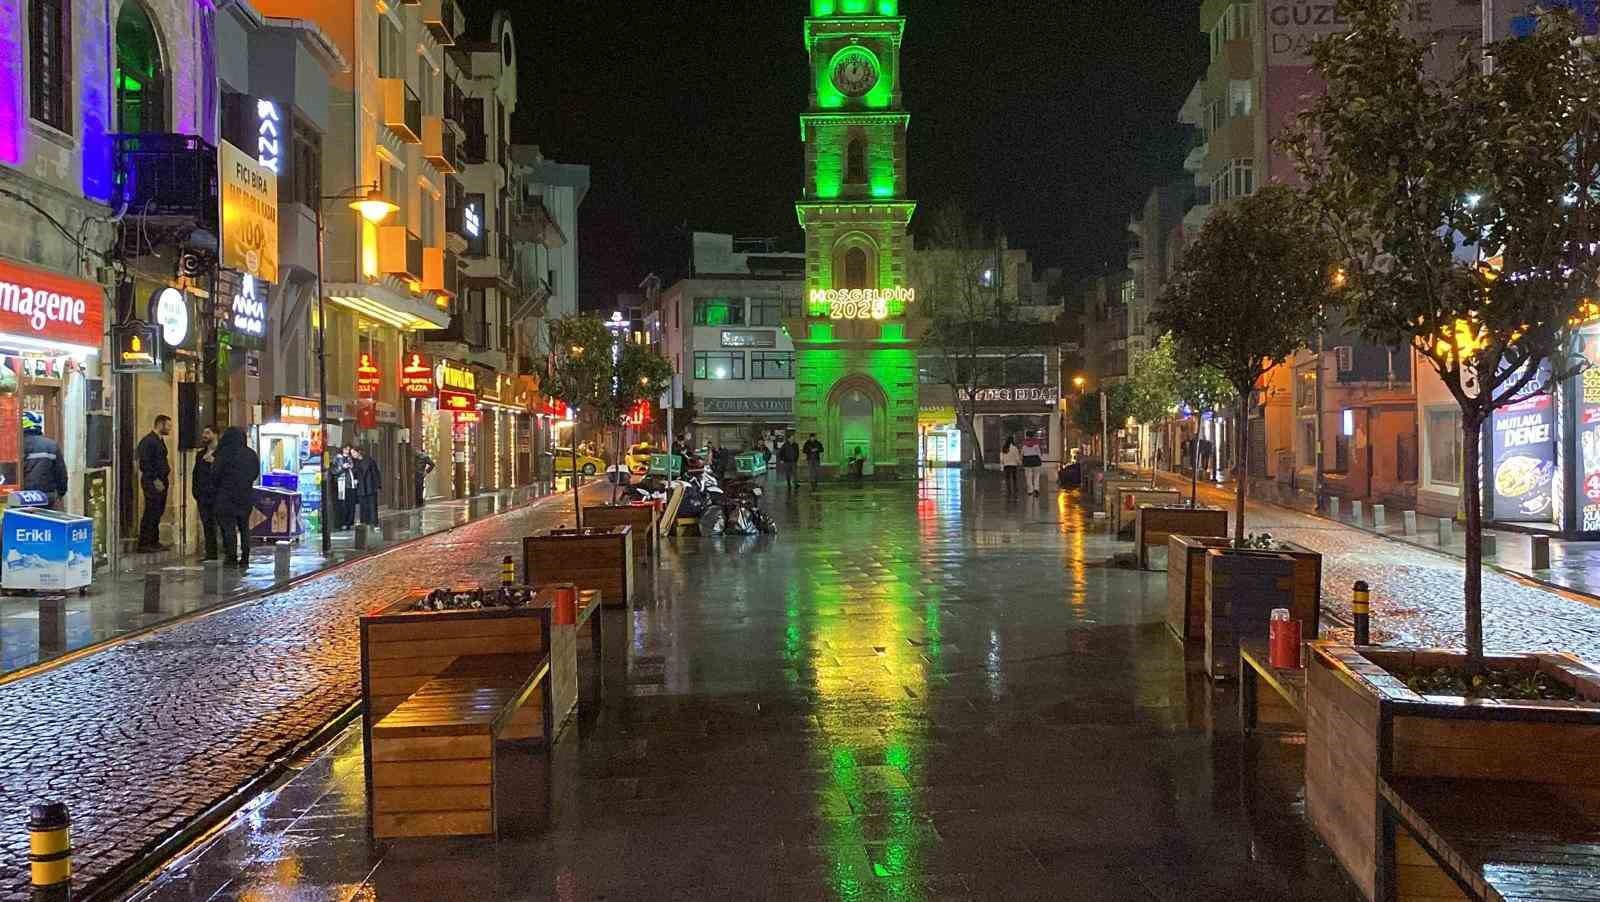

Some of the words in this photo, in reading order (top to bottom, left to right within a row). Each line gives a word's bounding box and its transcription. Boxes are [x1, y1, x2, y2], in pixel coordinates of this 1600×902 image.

[1496, 413, 1543, 431] MUTLAKA
[1504, 423, 1551, 448] DENE!
[16, 528, 52, 542] Erikli
